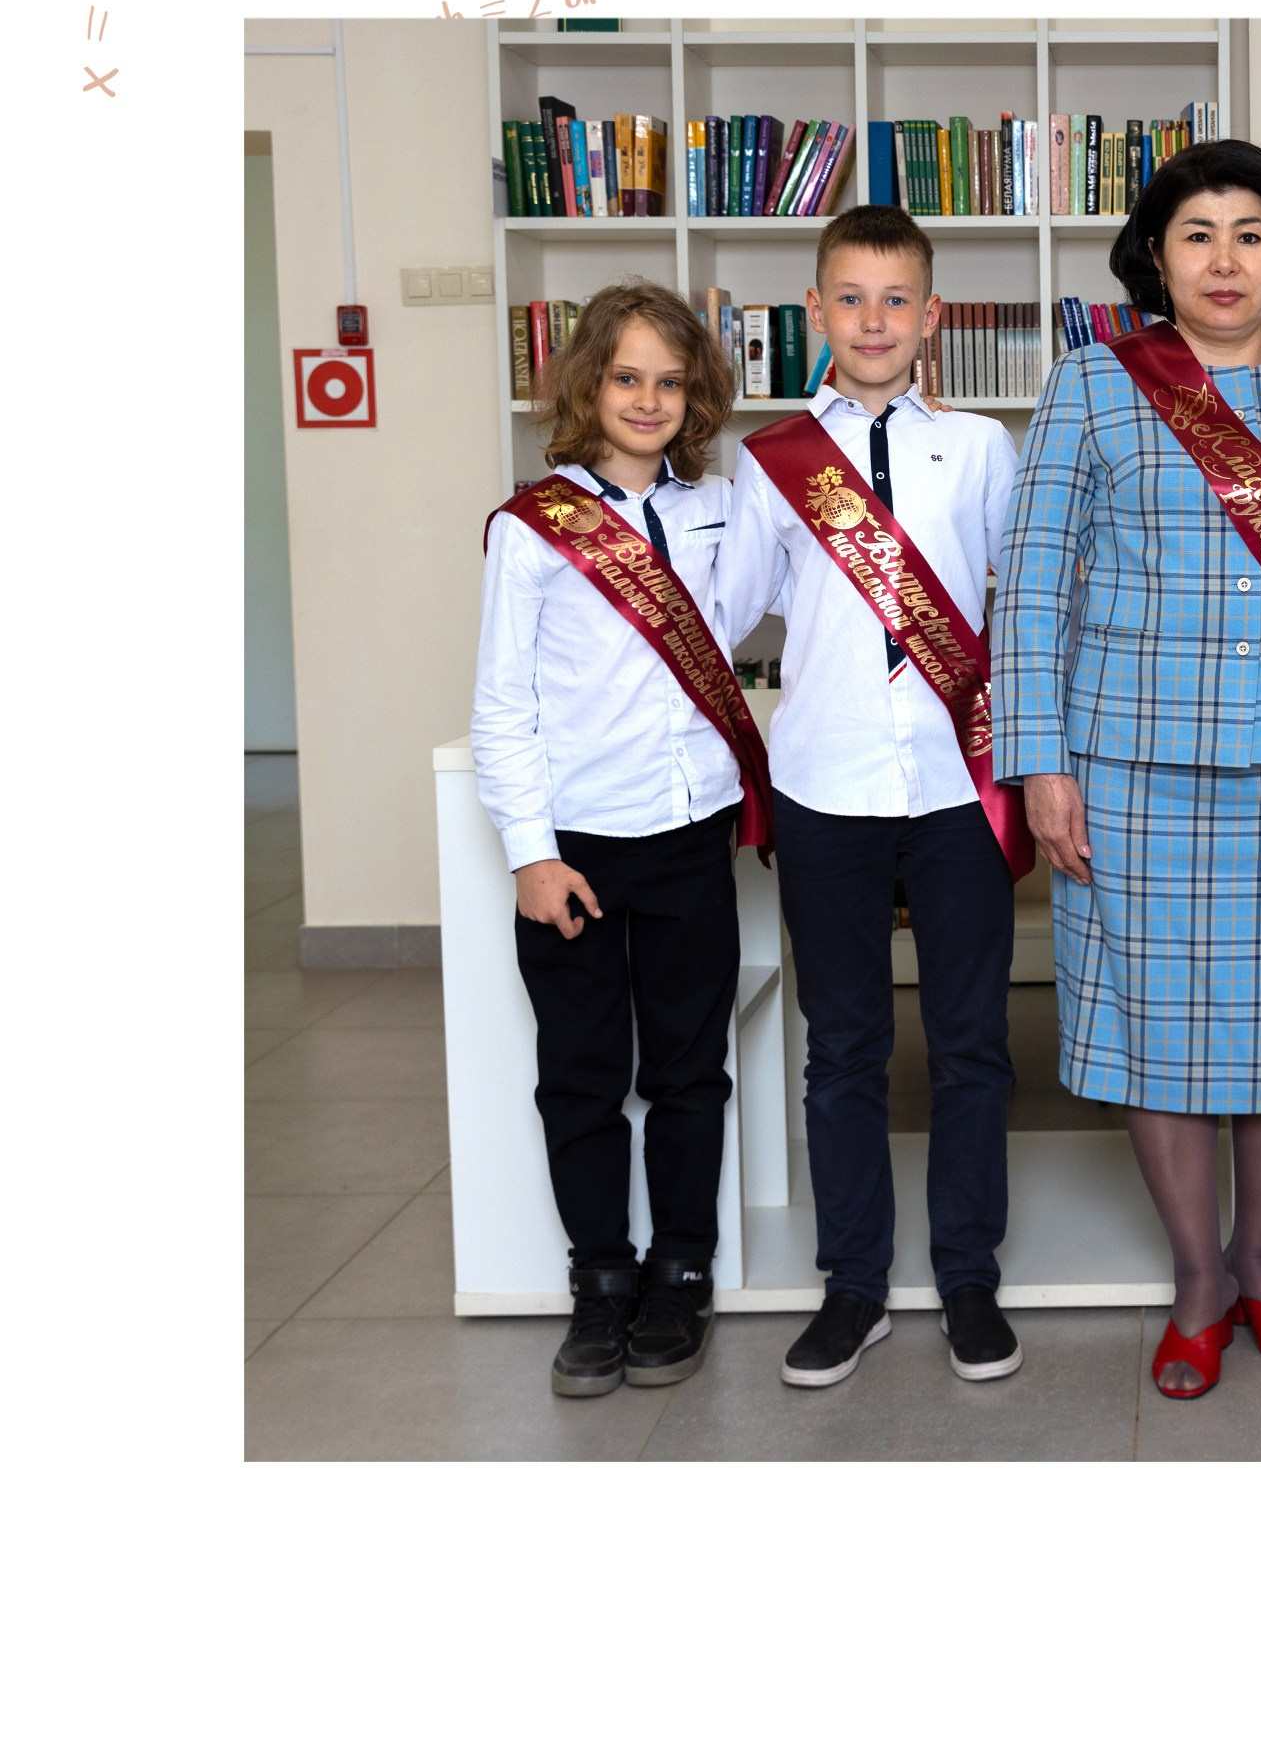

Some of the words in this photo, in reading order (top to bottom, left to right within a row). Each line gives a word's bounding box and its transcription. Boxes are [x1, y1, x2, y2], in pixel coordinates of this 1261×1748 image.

[570, 535, 668, 629] начальной
[662, 628, 713, 694] школы
[597, 530, 717, 669] Выпускник
[827, 531, 914, 631] начальной
[855, 529, 978, 677] Выпускник
[682, 1271, 703, 1281] FILA
